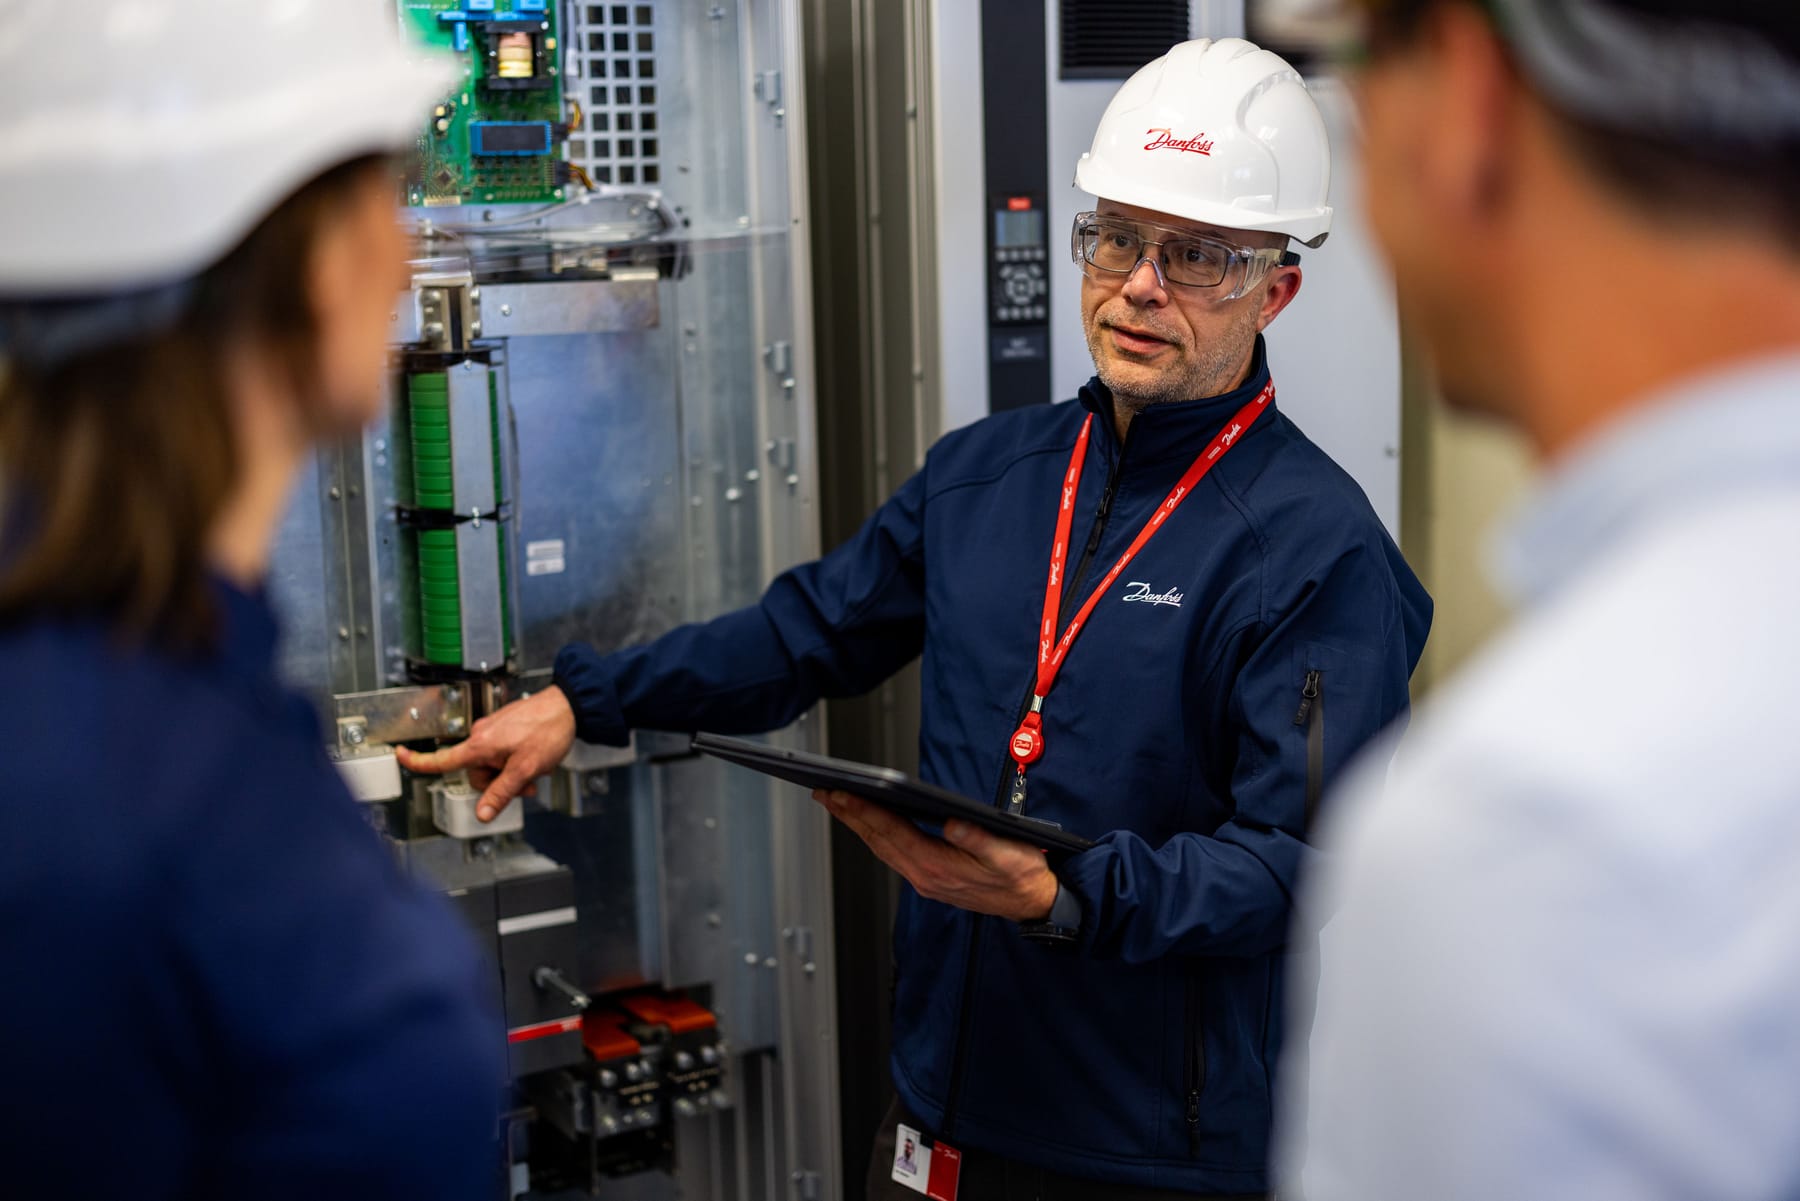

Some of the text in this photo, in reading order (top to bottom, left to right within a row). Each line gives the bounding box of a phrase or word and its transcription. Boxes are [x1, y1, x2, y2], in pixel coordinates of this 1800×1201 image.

[1144, 128, 1214, 156] Danfoss
[1051, 562, 1060, 586] Danf
[1123, 582, 1184, 607] Danfoss
[1063, 624, 1078, 646] Danf
[1041, 640, 1051, 664] Danf
